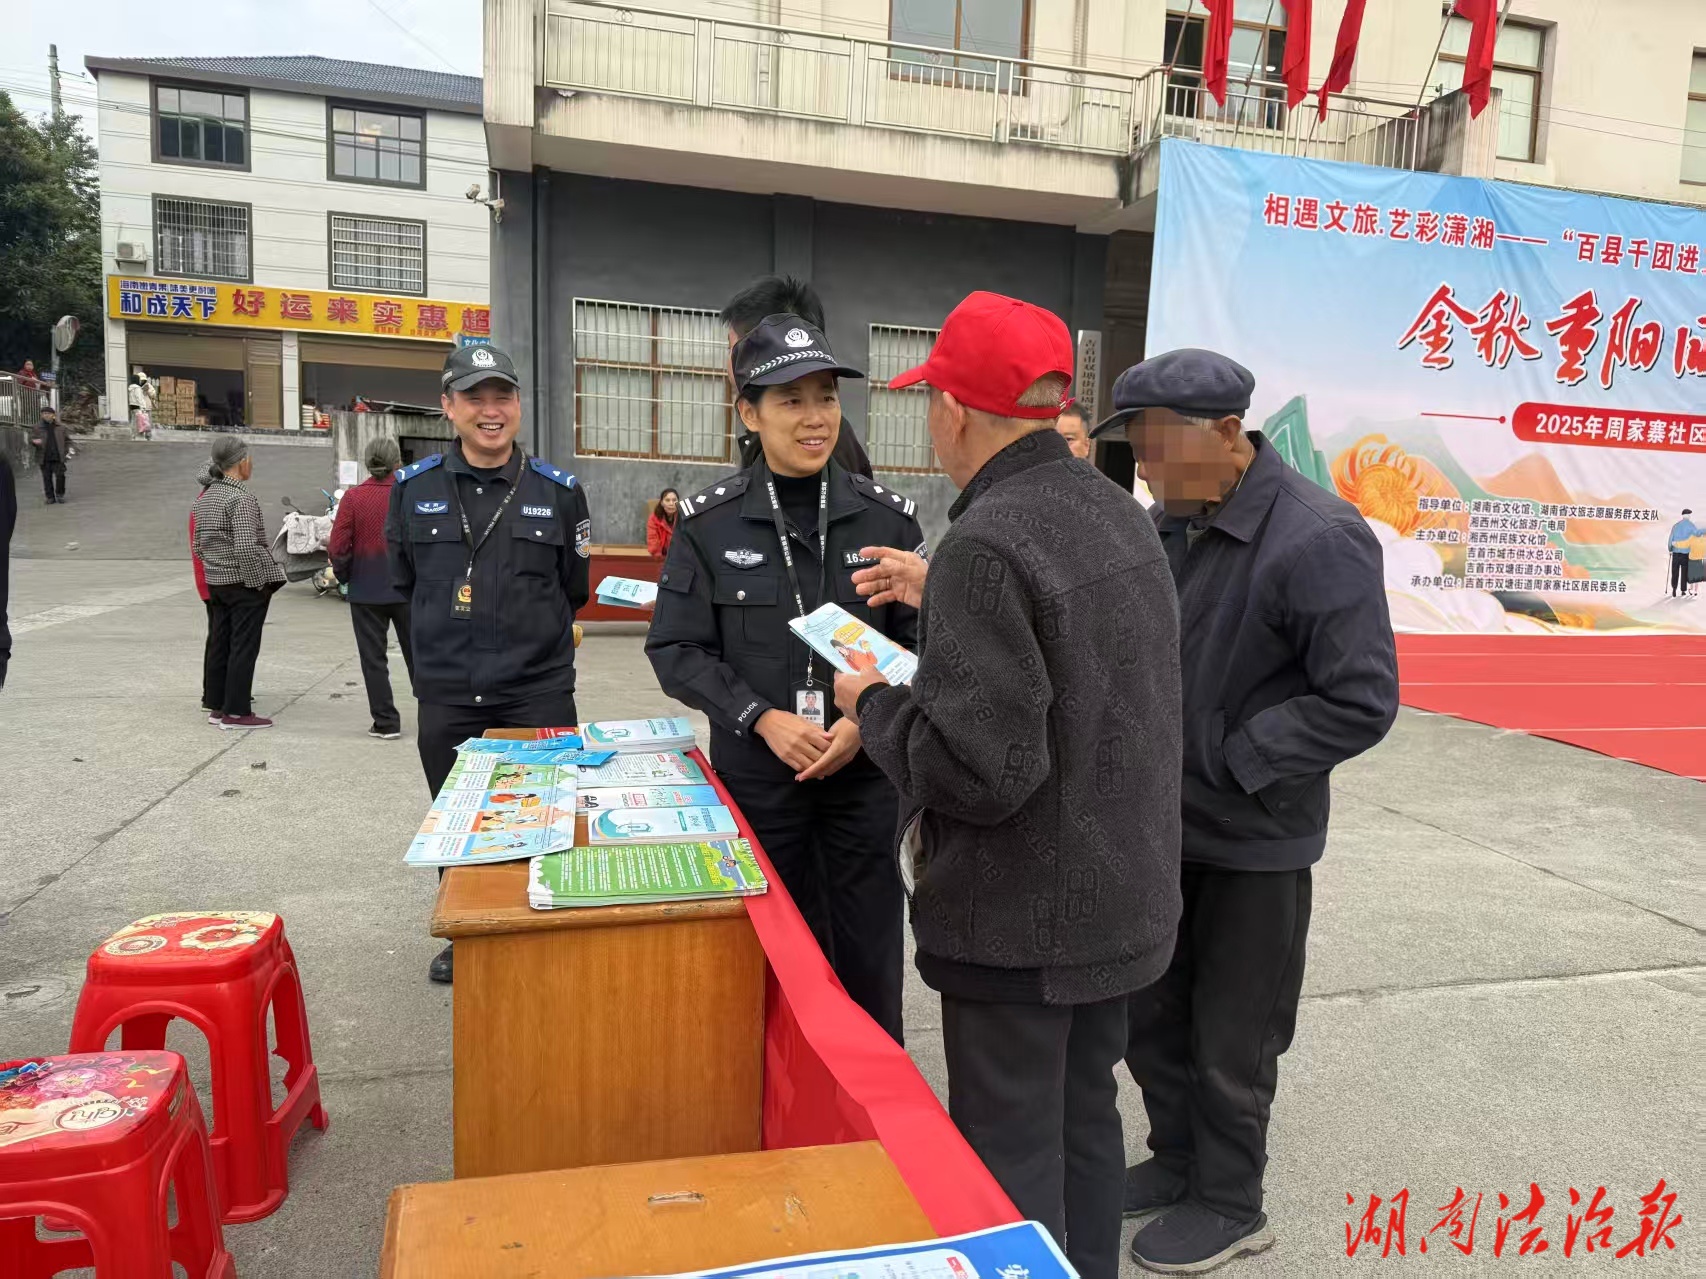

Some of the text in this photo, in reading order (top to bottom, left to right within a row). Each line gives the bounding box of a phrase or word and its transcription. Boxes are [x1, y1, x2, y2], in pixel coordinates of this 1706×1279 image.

[119, 291, 218, 320] 和成天下
[231, 288, 490, 334] 好运来实惠超
[1534, 412, 1706, 447] 2025年周家寨社区
[523, 506, 552, 516] U19226
[1469, 516, 1566, 532] 湘西州文化旅游广电局
[1467, 547, 1564, 562] 吉首市城市供水总公司
[1466, 563, 1562, 576] 吉首市双塘街道办事处
[737, 701, 759, 723] POLICE
